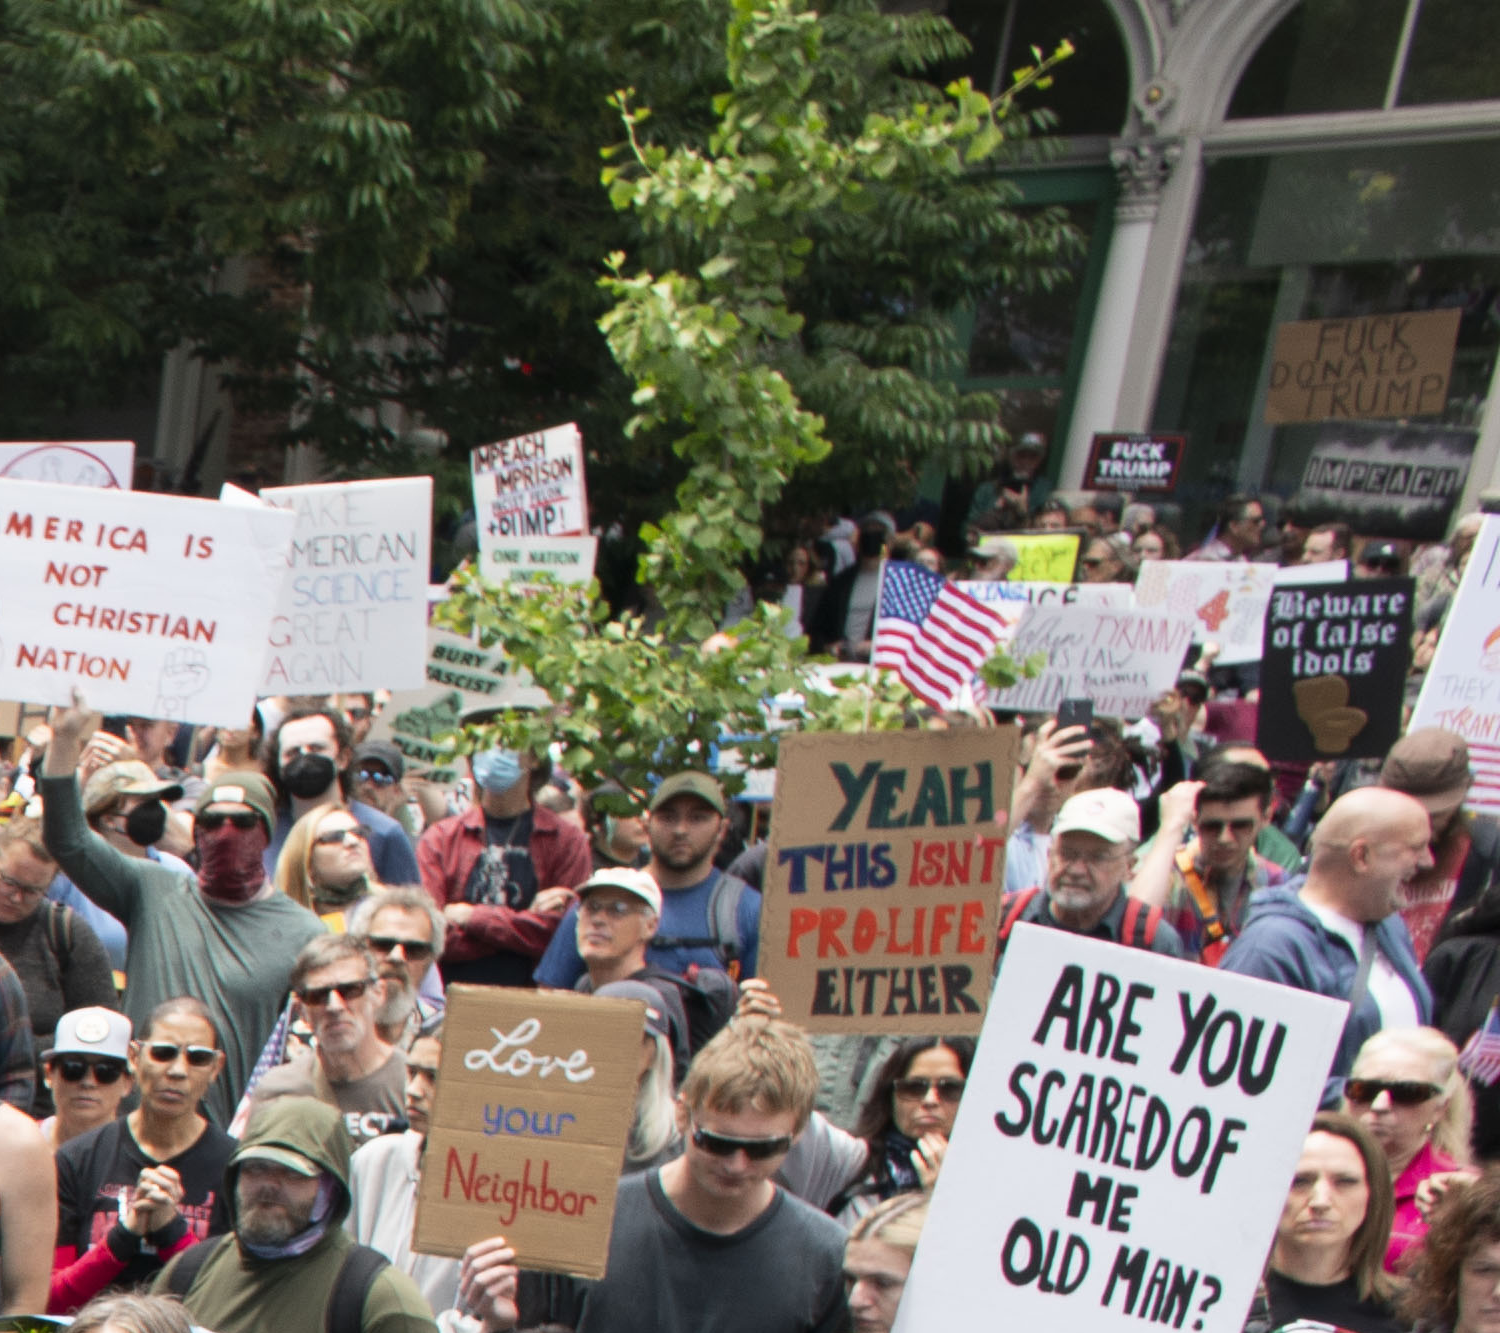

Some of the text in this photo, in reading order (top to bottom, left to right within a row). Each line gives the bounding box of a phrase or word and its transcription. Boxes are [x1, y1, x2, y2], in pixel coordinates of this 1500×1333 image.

[1317, 318, 1412, 362] FUCK
[1270, 353, 1422, 390] DONALD
[1303, 375, 1444, 418] TRUMP
[473, 432, 547, 470] IMPEACH
[1098, 459, 1172, 479] TRUMP
[1110, 442, 1164, 461] FUCK
[492, 457, 573, 491] IMPRISON
[1304, 455, 1468, 499] IMPEACH
[184, 534, 214, 559] IS
[46, 560, 109, 589] NOT
[292, 569, 413, 607] SCIENCE
[53, 601, 217, 644] CHRISTIAN
[268, 607, 375, 645] GREAT
[1272, 590, 1405, 623] Beware
[1273, 621, 1396, 649] of false
[15, 642, 132, 682] NATION
[264, 648, 364, 686] AGAIN
[432, 645, 487, 667] BURY
[1292, 647, 1374, 677] idols
[826, 759, 994, 833] YEAH
[778, 842, 898, 894] THIS
[786, 900, 988, 958] PRO-LIFE
[811, 966, 980, 1016] EITHER
[465, 1017, 595, 1084] Love
[1033, 964, 1288, 1098] ARE YOU
[484, 1102, 575, 1138] your
[994, 1064, 1248, 1195] SCARED OF
[444, 1146, 598, 1225] Neighbor
[1067, 1172, 1133, 1234] ME
[1000, 1229, 1223, 1332] OLD MAN?
